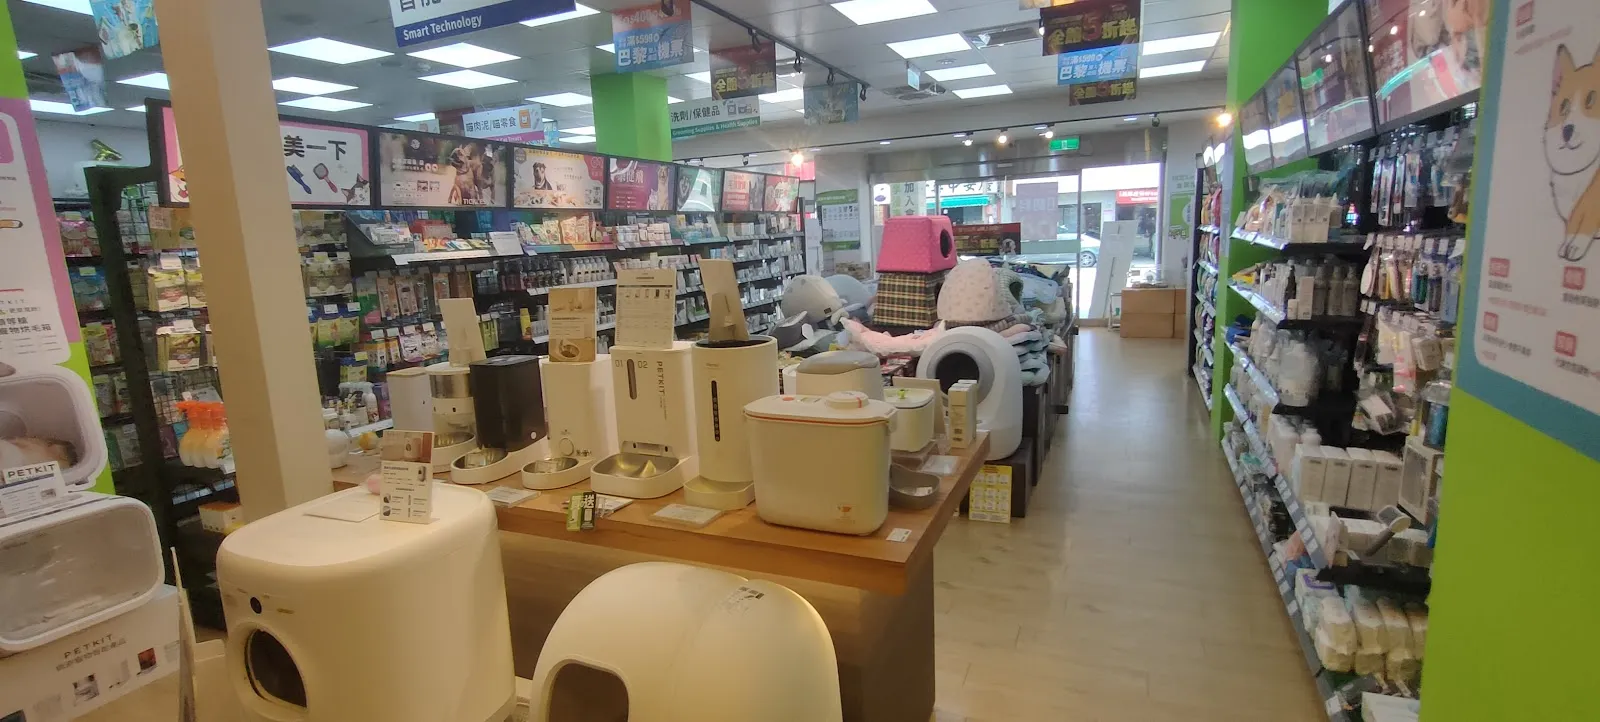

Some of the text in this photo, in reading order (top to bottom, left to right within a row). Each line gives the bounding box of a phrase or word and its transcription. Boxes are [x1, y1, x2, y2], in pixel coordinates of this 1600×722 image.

[403, 14, 482, 41] Smart Technology
[283, 134, 347, 161] 美一下
[637, 360, 649, 369] 02
[656, 361, 666, 396] PETKIT
[7, 463, 56, 478] PETKIT
[63, 633, 113, 659] PETKIT
